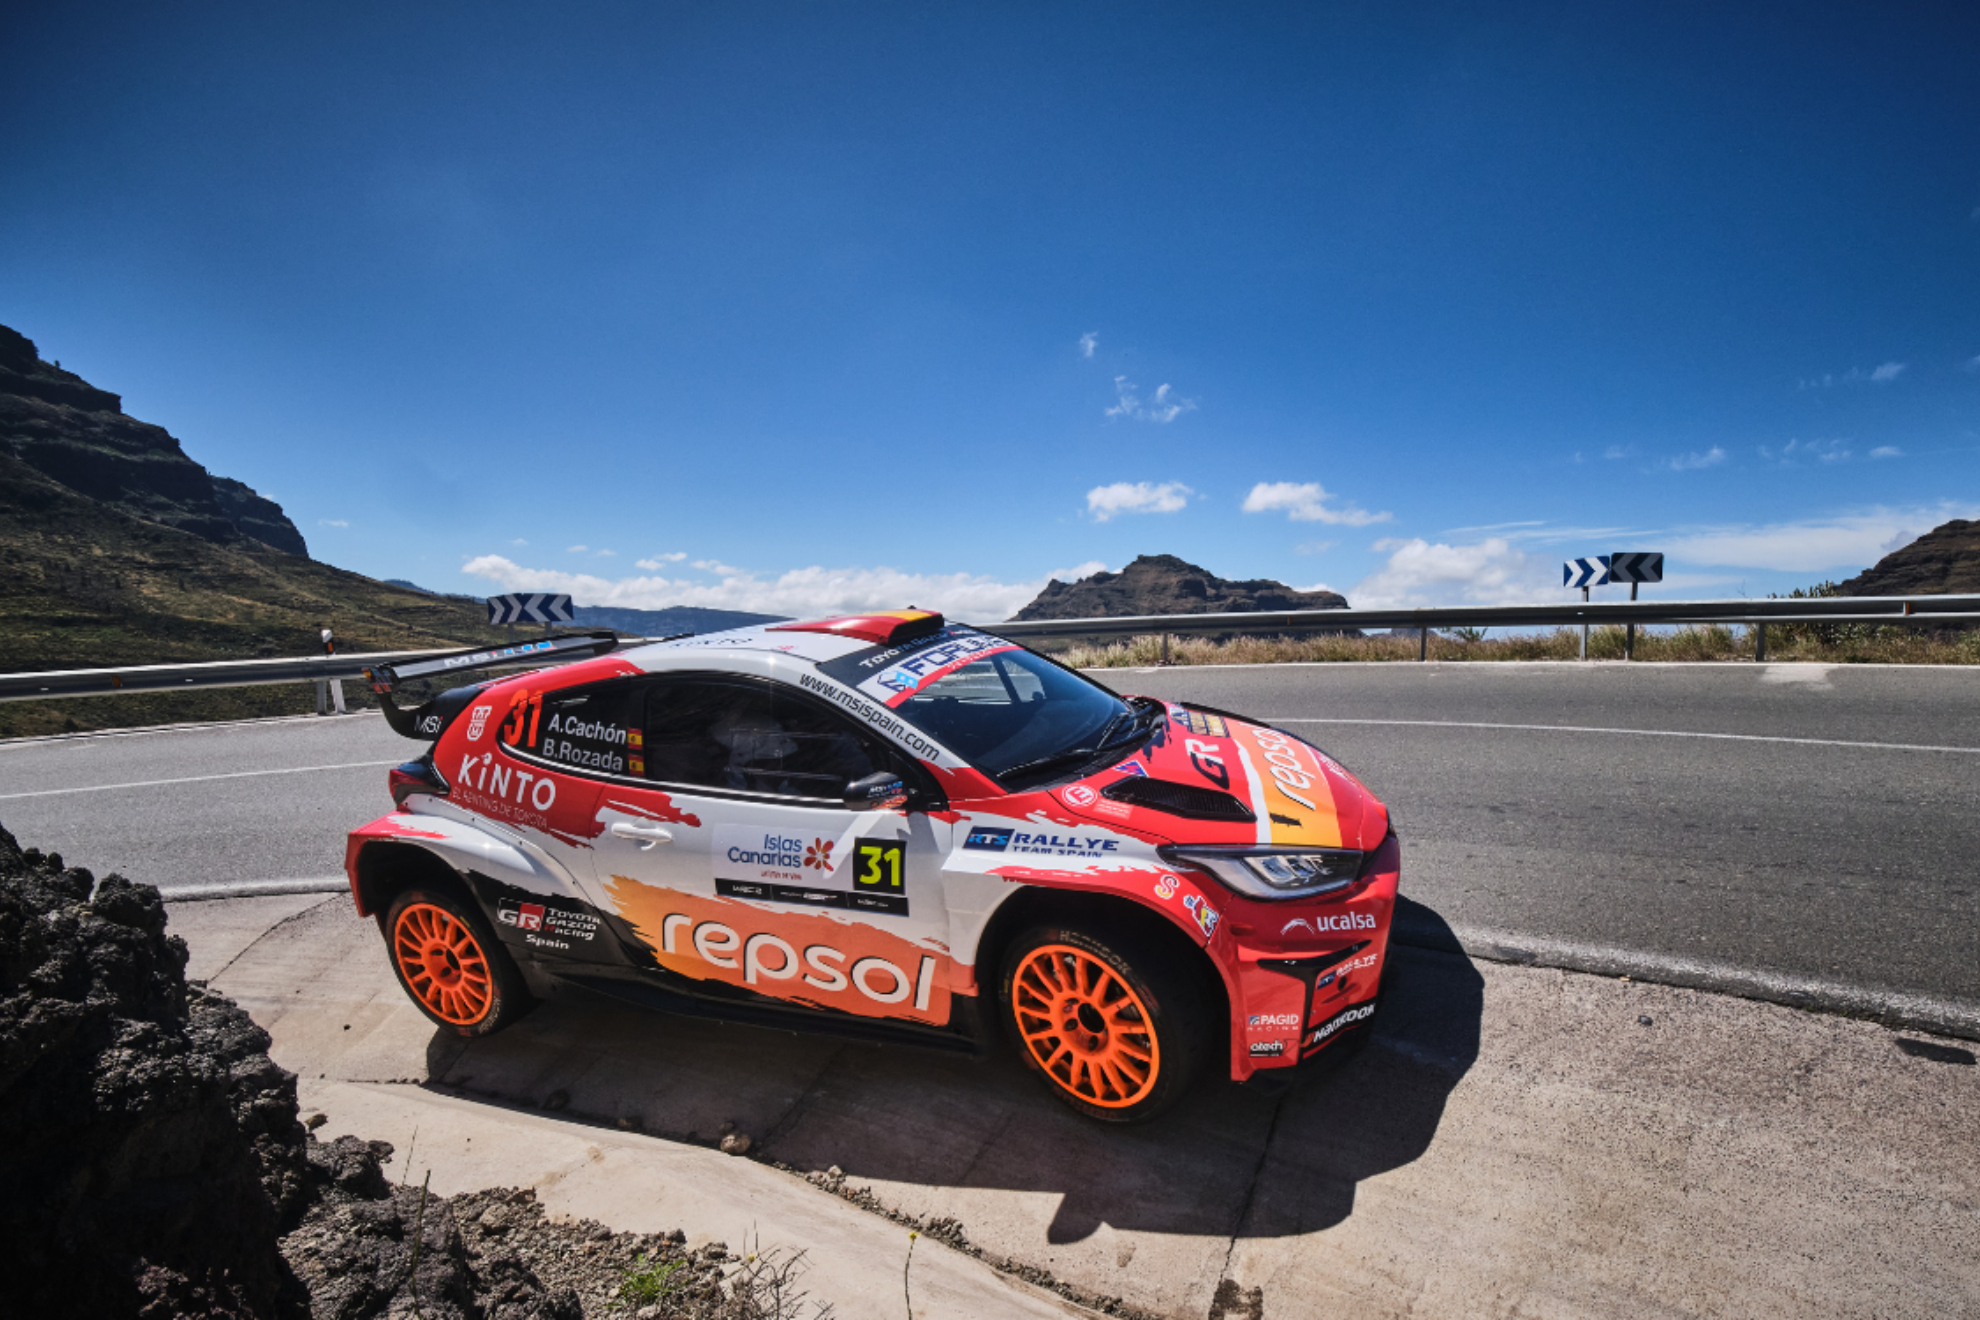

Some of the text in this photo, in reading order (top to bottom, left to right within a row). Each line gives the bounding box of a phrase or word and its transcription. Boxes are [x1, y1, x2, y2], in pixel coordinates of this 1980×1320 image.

[503, 689, 543, 748] 31
[799, 673, 940, 761] www.msispain.com
[548, 713, 627, 744] A.Cachón
[542, 738, 623, 772] B.Rozada
[1185, 738, 1229, 790] GR
[764, 833, 802, 852] Islas
[968, 833, 1008, 846] RTS
[1013, 833, 1119, 851] RALLYE
[727, 846, 802, 868] Canarias
[1013, 845, 1103, 858] TEAM SPAIN
[859, 845, 901, 886] 31
[499, 908, 541, 930] GR
[546, 916, 597, 930] GAZOO
[548, 907, 600, 924] TOYOTA
[1316, 911, 1376, 932] ucalsa
[525, 934, 570, 949] Spain
[662, 912, 936, 1011] repsol
[1260, 1013, 1299, 1025] PAGID
